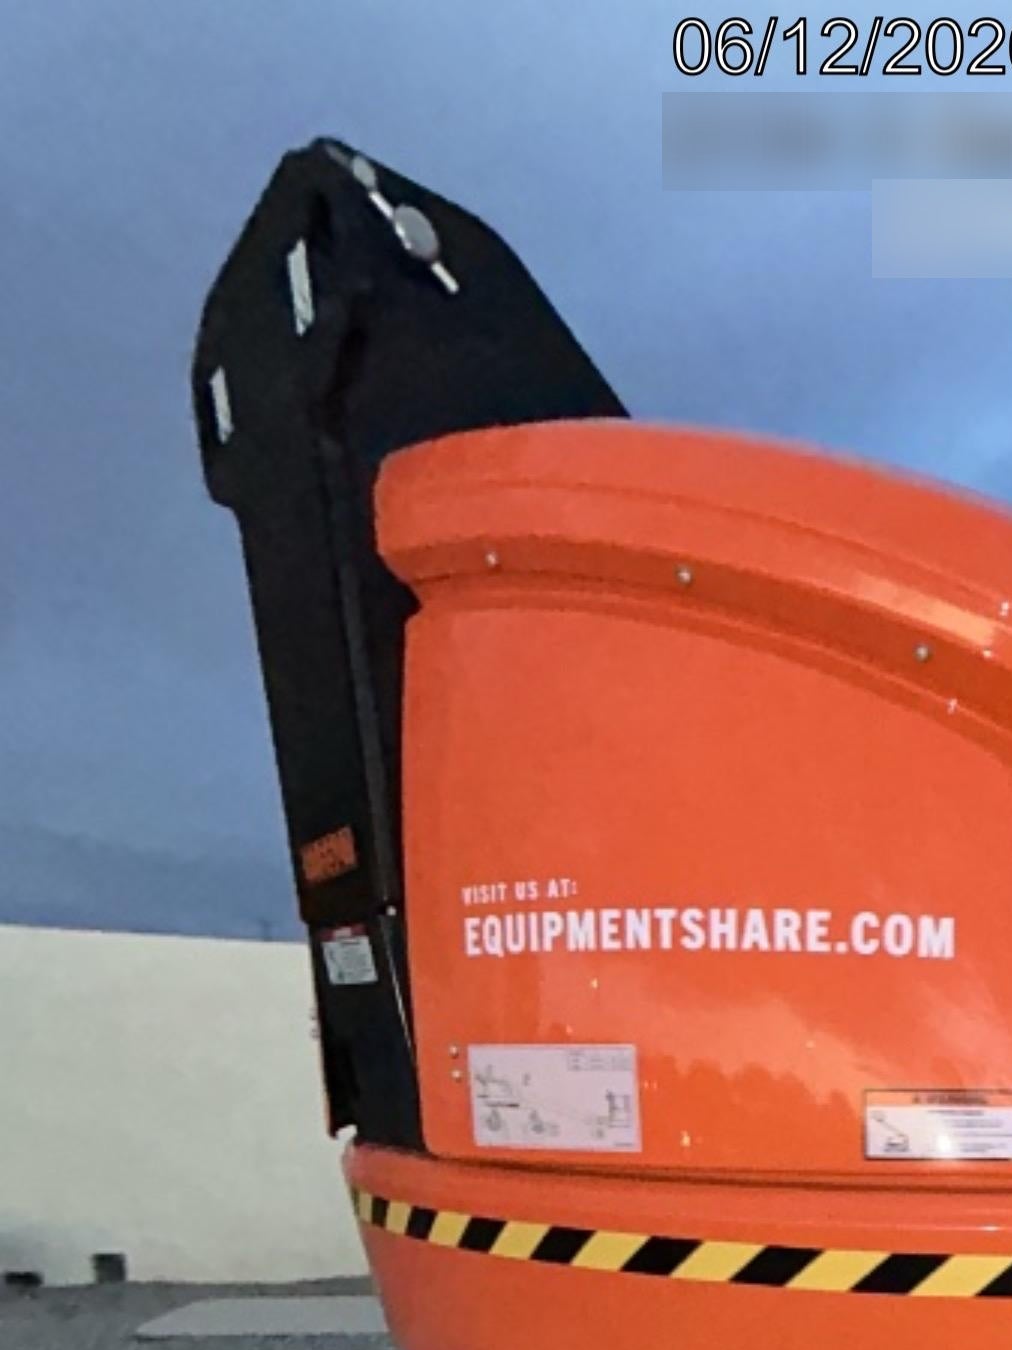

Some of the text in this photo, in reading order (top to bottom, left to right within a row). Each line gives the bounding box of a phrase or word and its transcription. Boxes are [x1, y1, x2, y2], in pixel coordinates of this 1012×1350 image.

[461, 878, 577, 905] VISIT US AT:
[464, 908, 955, 960] EQUIPMENTSHARE.COM
